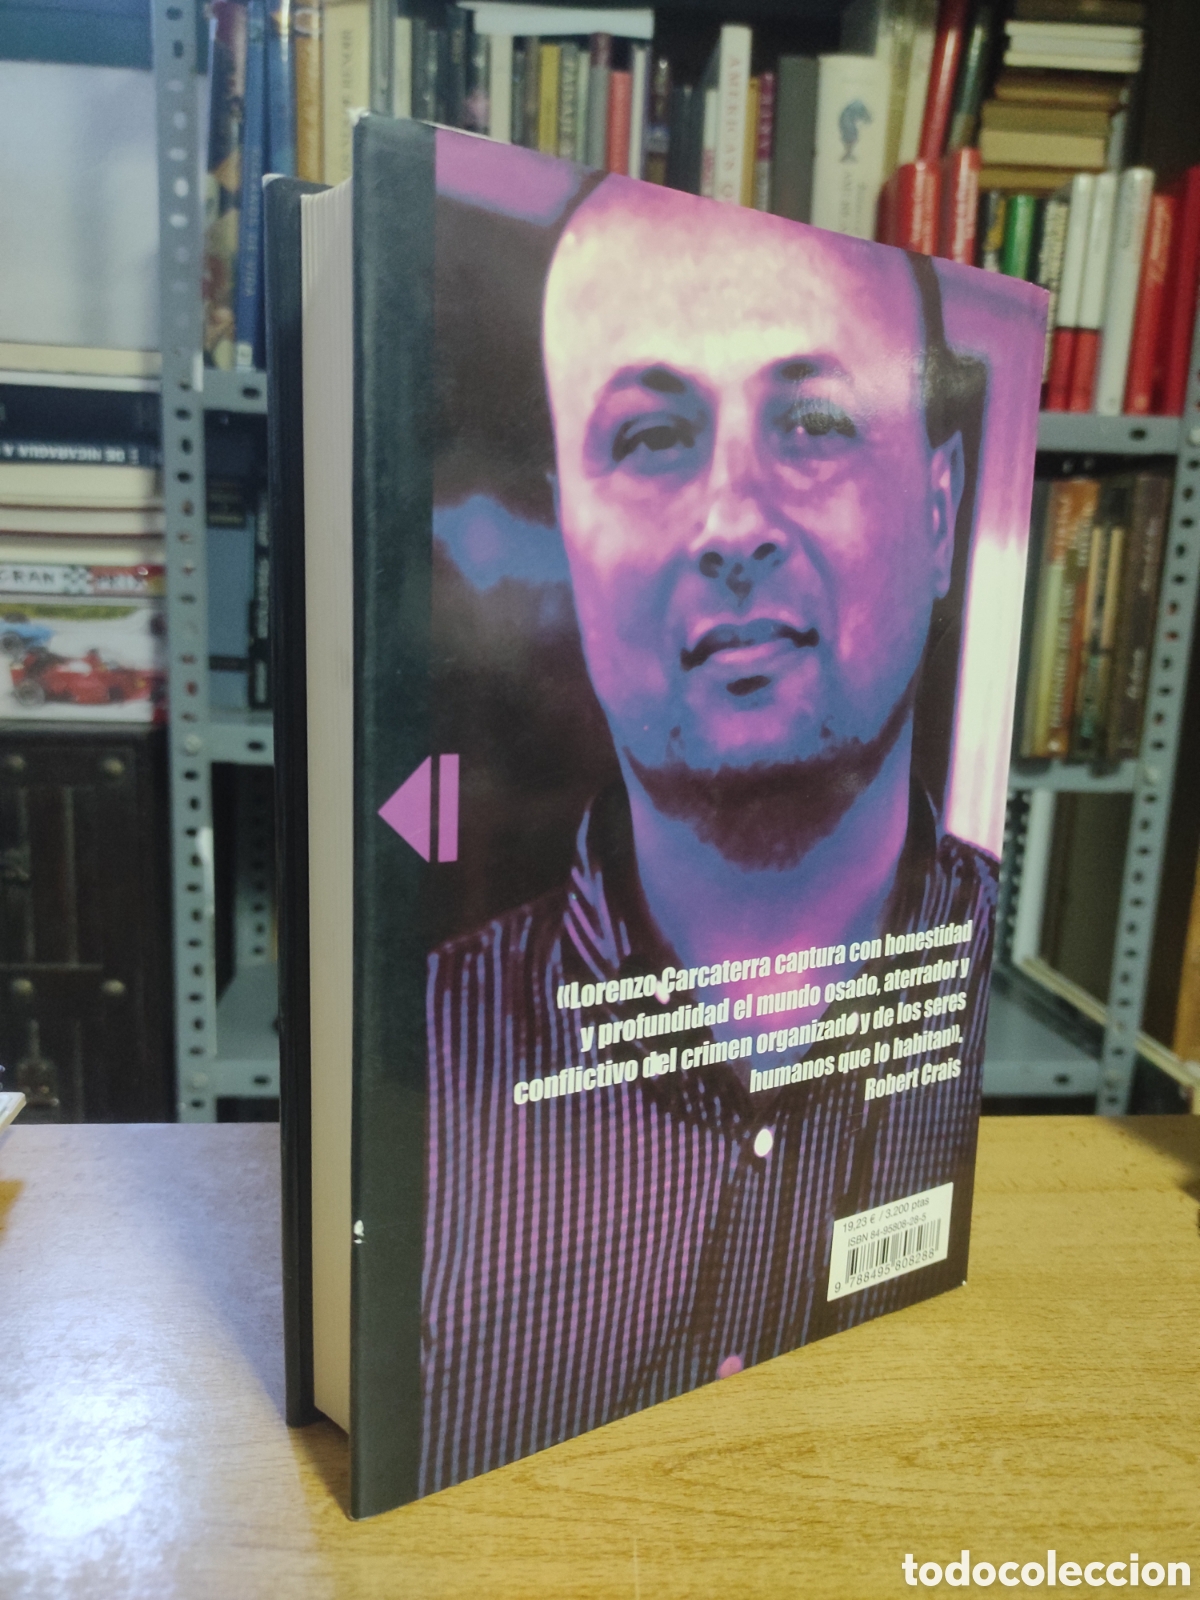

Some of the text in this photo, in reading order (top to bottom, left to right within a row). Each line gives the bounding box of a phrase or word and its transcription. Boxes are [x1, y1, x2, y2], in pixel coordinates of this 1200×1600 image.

[557, 920, 973, 1009] «Lorenzo Carcaterra captura con honestidad
[580, 957, 970, 1052] y profundidad el mundo osado, aterrador y
[513, 992, 967, 1105] conflictivo del crimen organizado y de los seres
[750, 1025, 963, 1093] humanos que lo habitan».
[865, 1058, 961, 1100] Robert Crais
[843, 1216, 867, 1233] 19,23
[870, 1213, 876, 1224] €
[885, 1202, 910, 1219] 3.200
[911, 1197, 930, 1212] ptas
[848, 1233, 869, 1248] ISBN
[834, 1248, 935, 1293] 9 788495 808288
